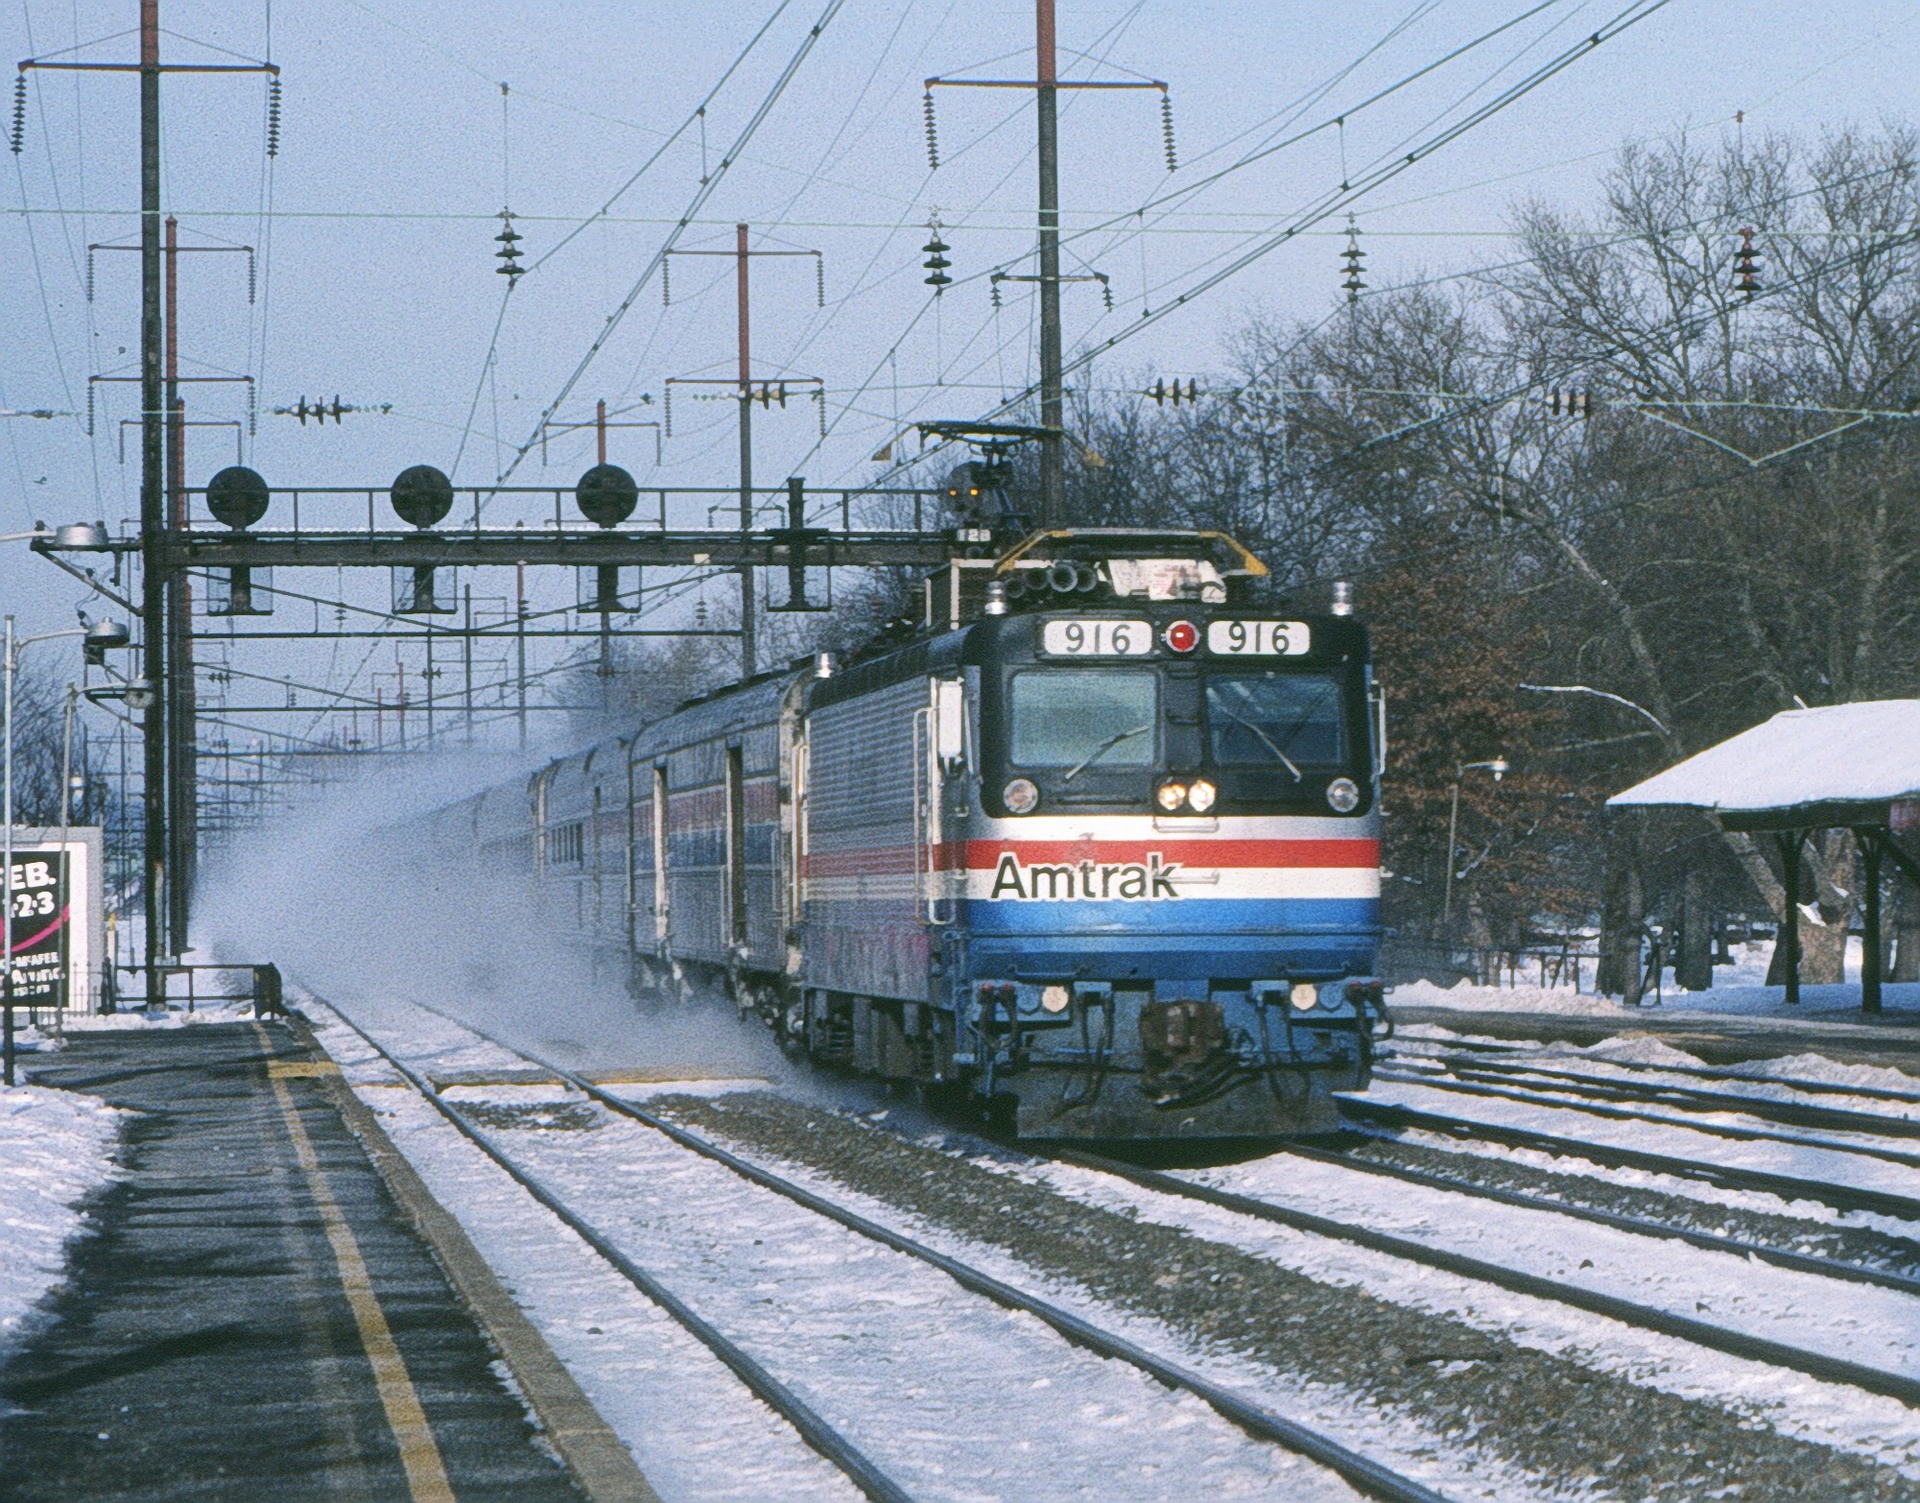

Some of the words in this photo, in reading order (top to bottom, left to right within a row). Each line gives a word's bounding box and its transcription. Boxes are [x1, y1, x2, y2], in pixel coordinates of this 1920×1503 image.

[1065, 623, 1131, 654] 916
[1228, 622, 1291, 654] 916
[990, 853, 1182, 900] Amtrak
